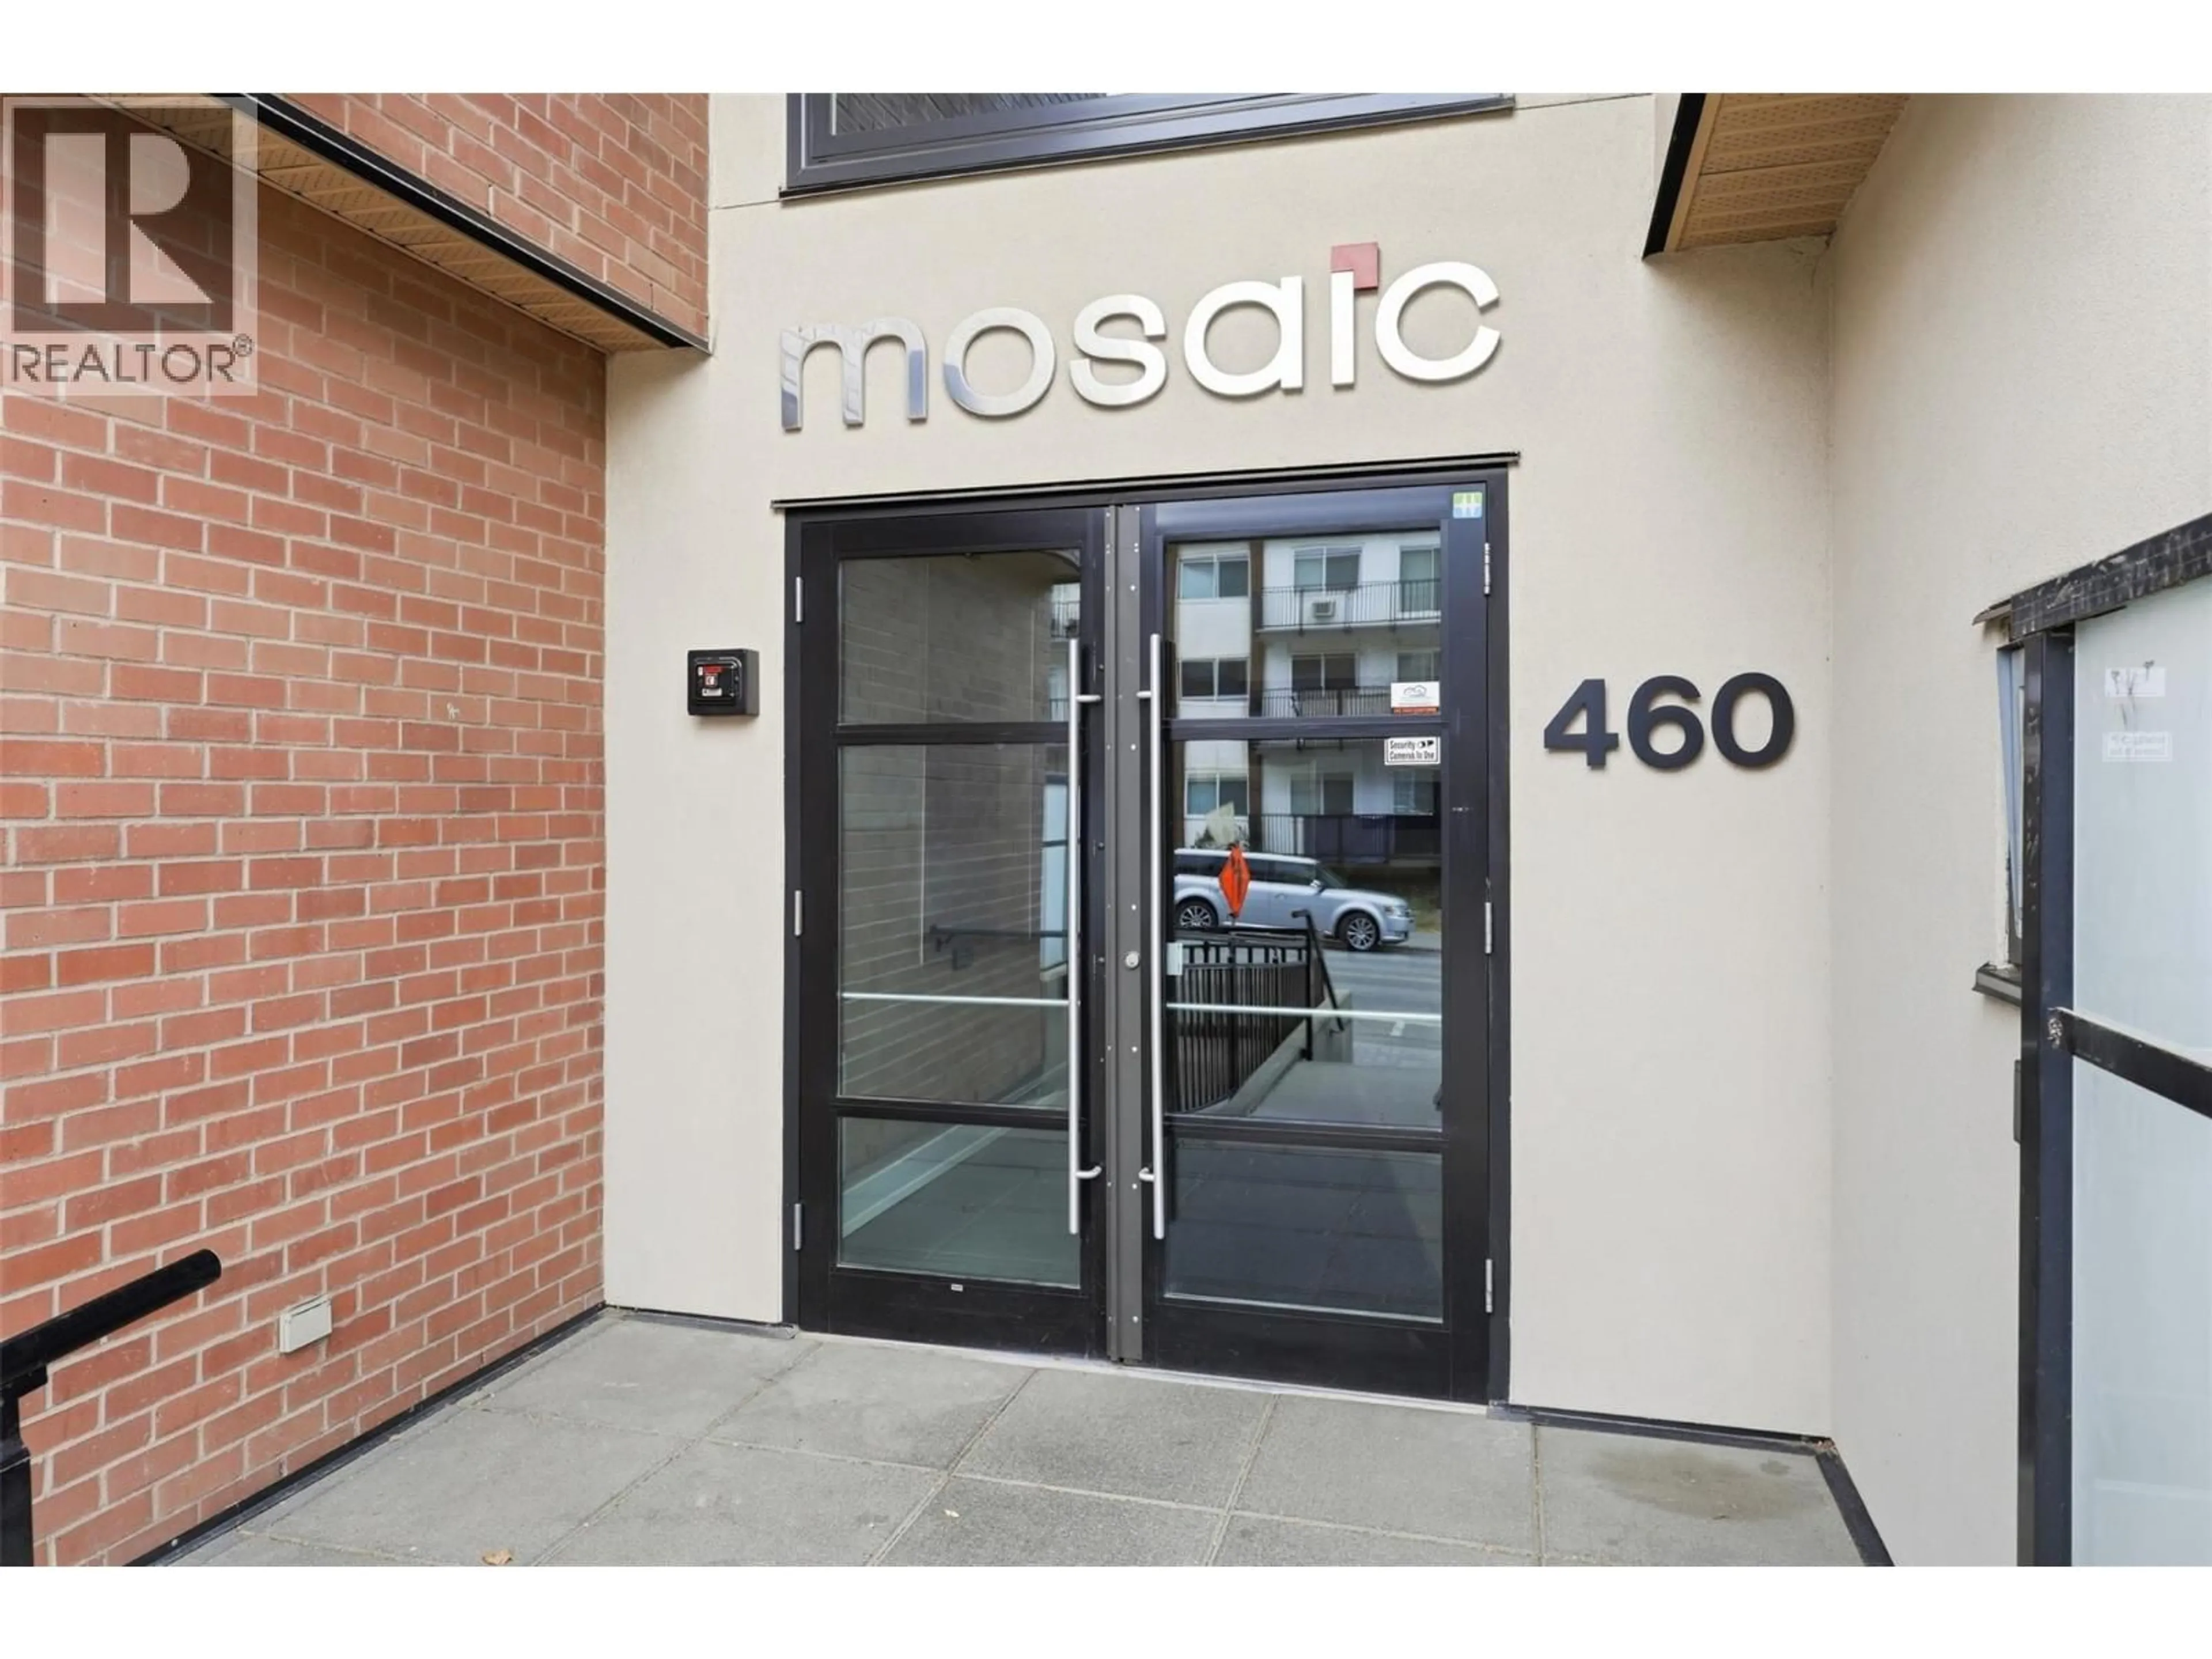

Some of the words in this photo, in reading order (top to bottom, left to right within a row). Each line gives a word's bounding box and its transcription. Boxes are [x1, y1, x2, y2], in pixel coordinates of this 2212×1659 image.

[780, 242, 1502, 432] mosaic
[1390, 740, 1415, 751] Security
[1543, 672, 1796, 770] 460
